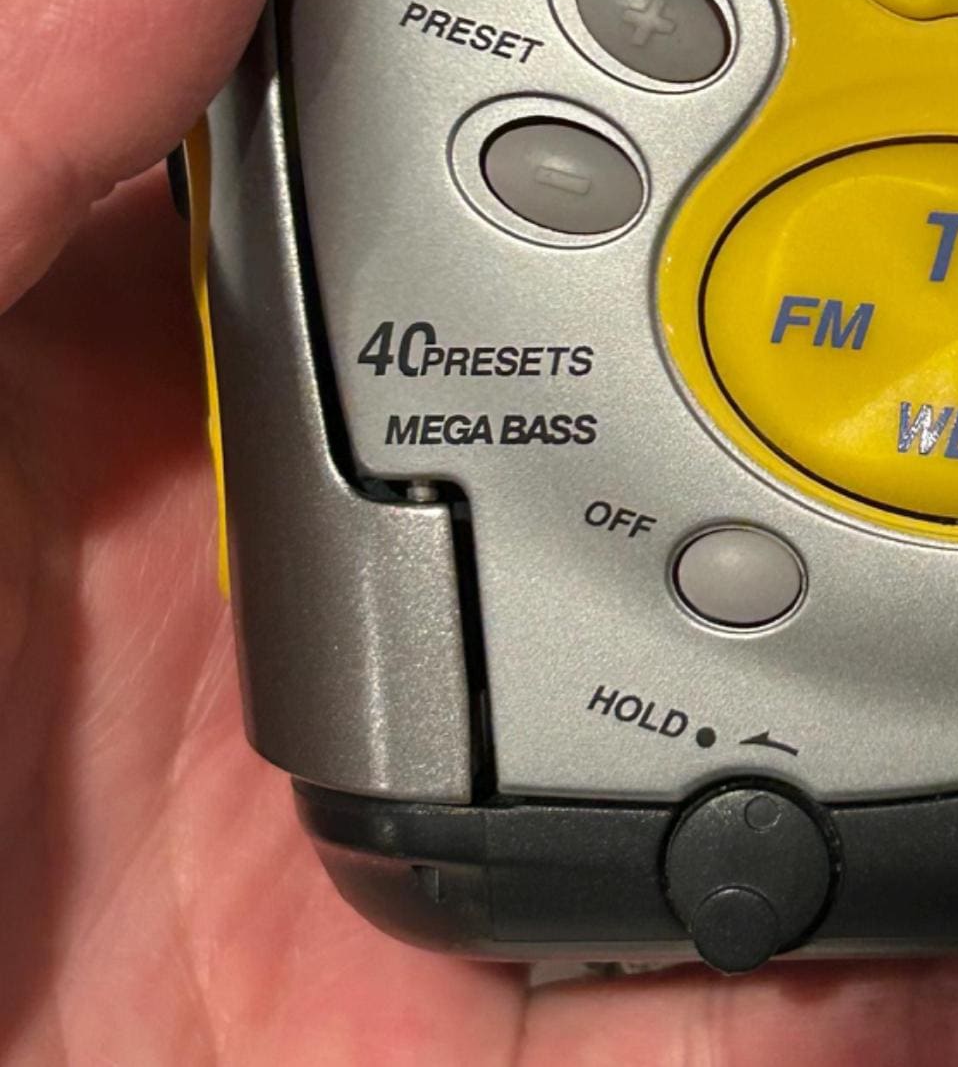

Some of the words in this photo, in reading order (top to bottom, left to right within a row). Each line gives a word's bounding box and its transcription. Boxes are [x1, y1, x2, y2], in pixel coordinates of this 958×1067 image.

[399, 1, 545, 63] PRESET
[770, 295, 875, 351] FM
[420, 345, 595, 376] PRESETS
[384, 415, 493, 444] MEGA
[500, 414, 598, 444] BASS
[584, 500, 657, 538] OFF
[586, 685, 689, 738] HOLD
